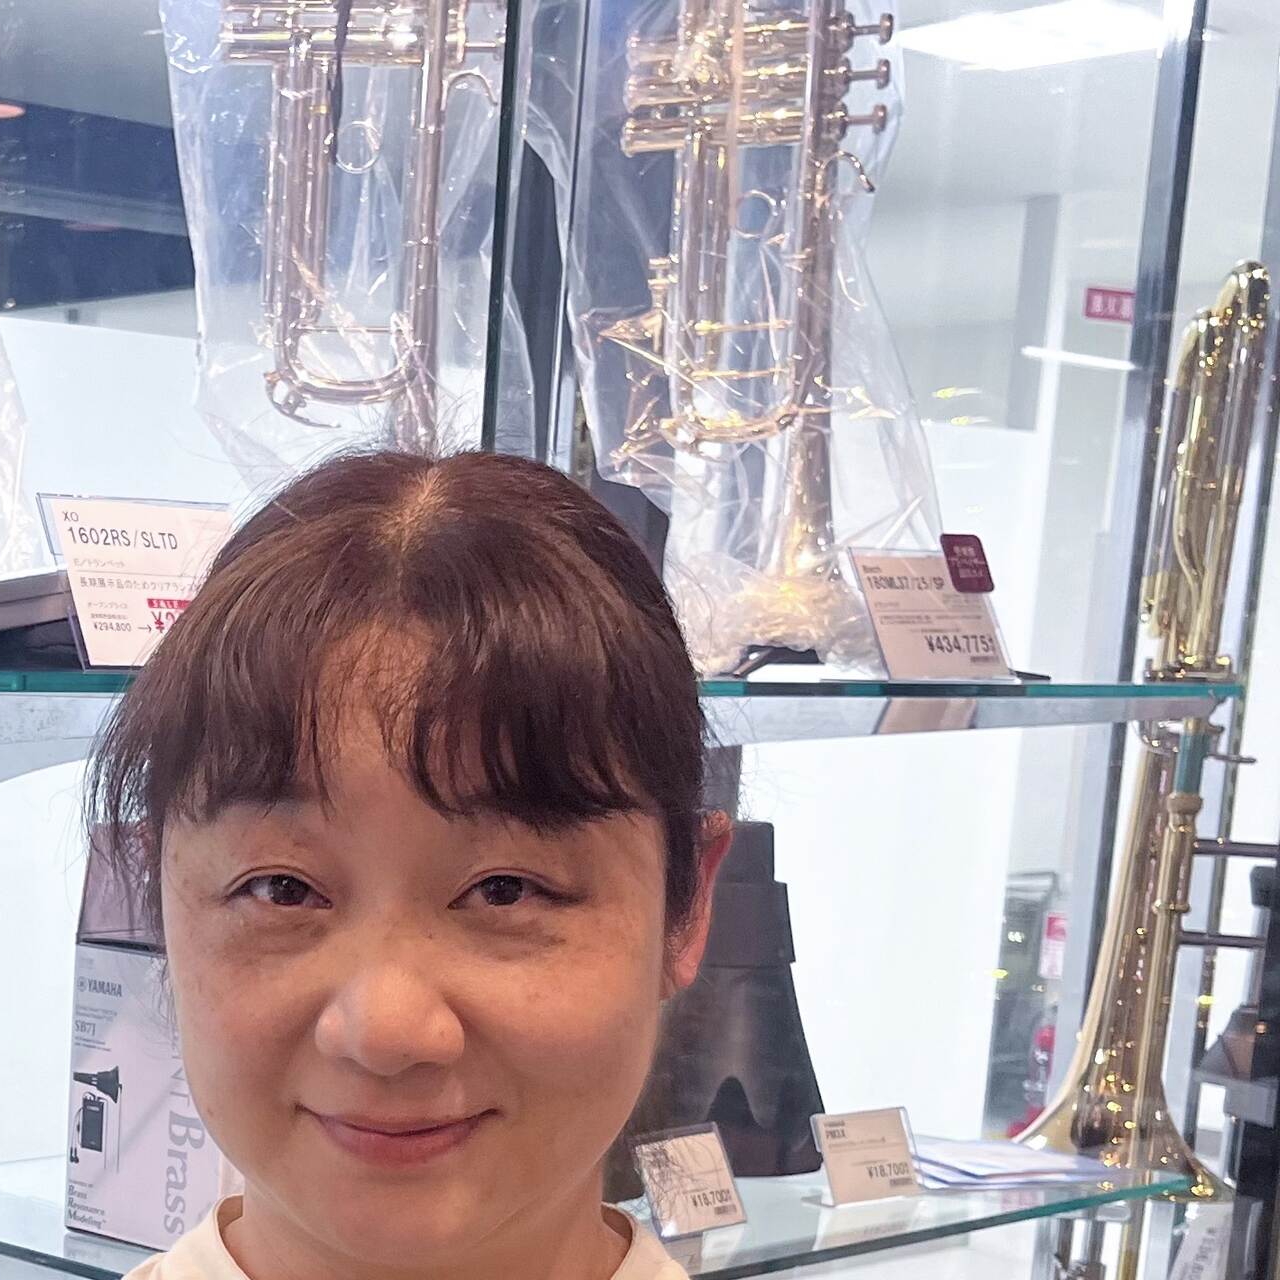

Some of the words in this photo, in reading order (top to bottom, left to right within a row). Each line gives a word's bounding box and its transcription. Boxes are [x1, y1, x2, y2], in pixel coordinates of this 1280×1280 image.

[62, 511, 79, 522] XO
[67, 526, 178, 550] 1602RS/SLTD
[87, 979, 122, 997] YAMAHA
[163, 1110, 206, 1235] Brass
